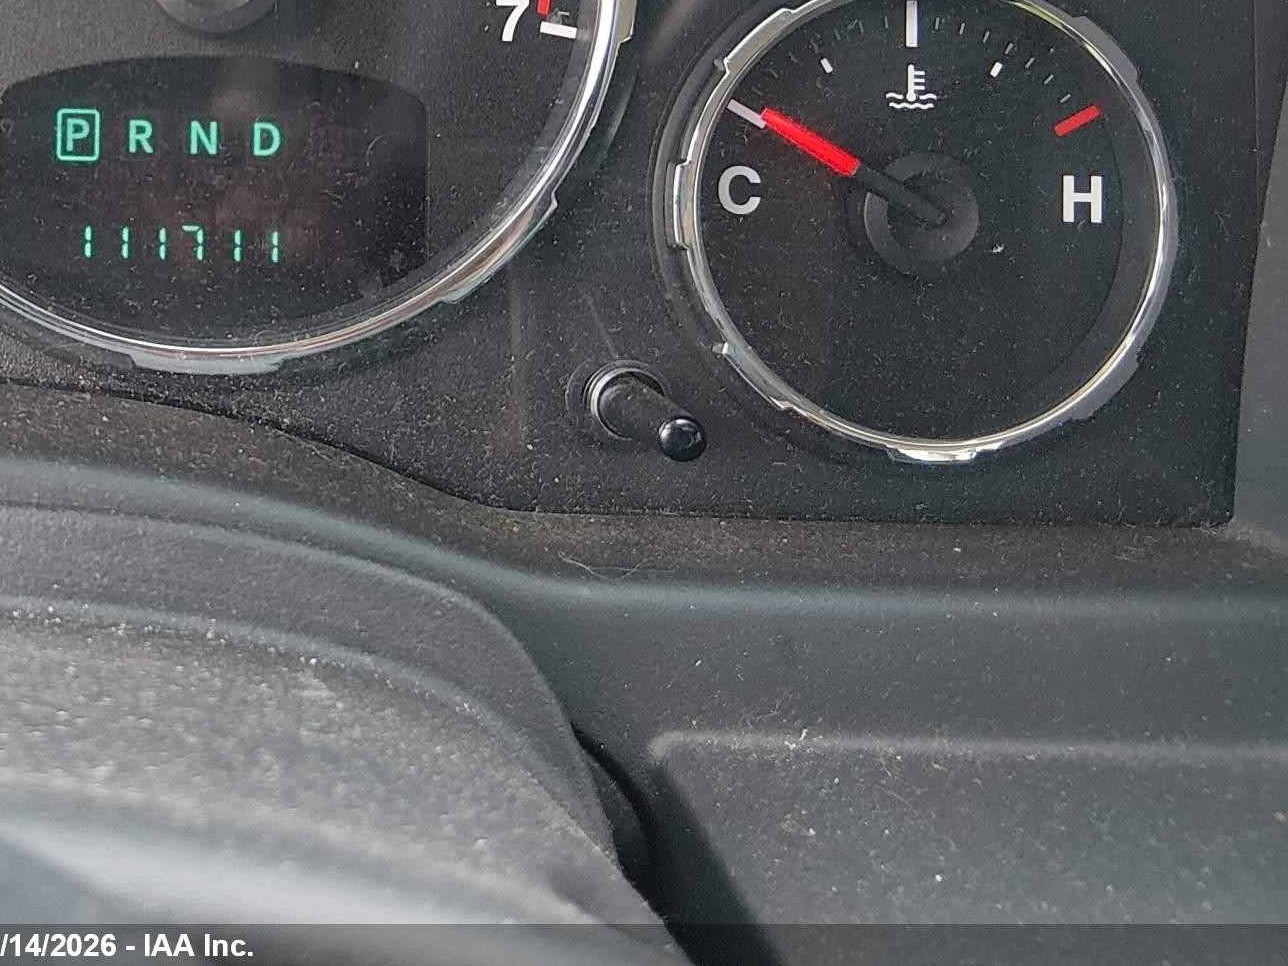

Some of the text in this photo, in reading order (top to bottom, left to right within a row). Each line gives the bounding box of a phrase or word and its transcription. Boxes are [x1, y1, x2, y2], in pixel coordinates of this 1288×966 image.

[129, 119, 154, 154] R
[190, 121, 218, 154] N
[253, 122, 281, 156] D
[717, 165, 762, 215] C
[1062, 175, 1103, 223] H
[84, 225, 279, 263] 111711
